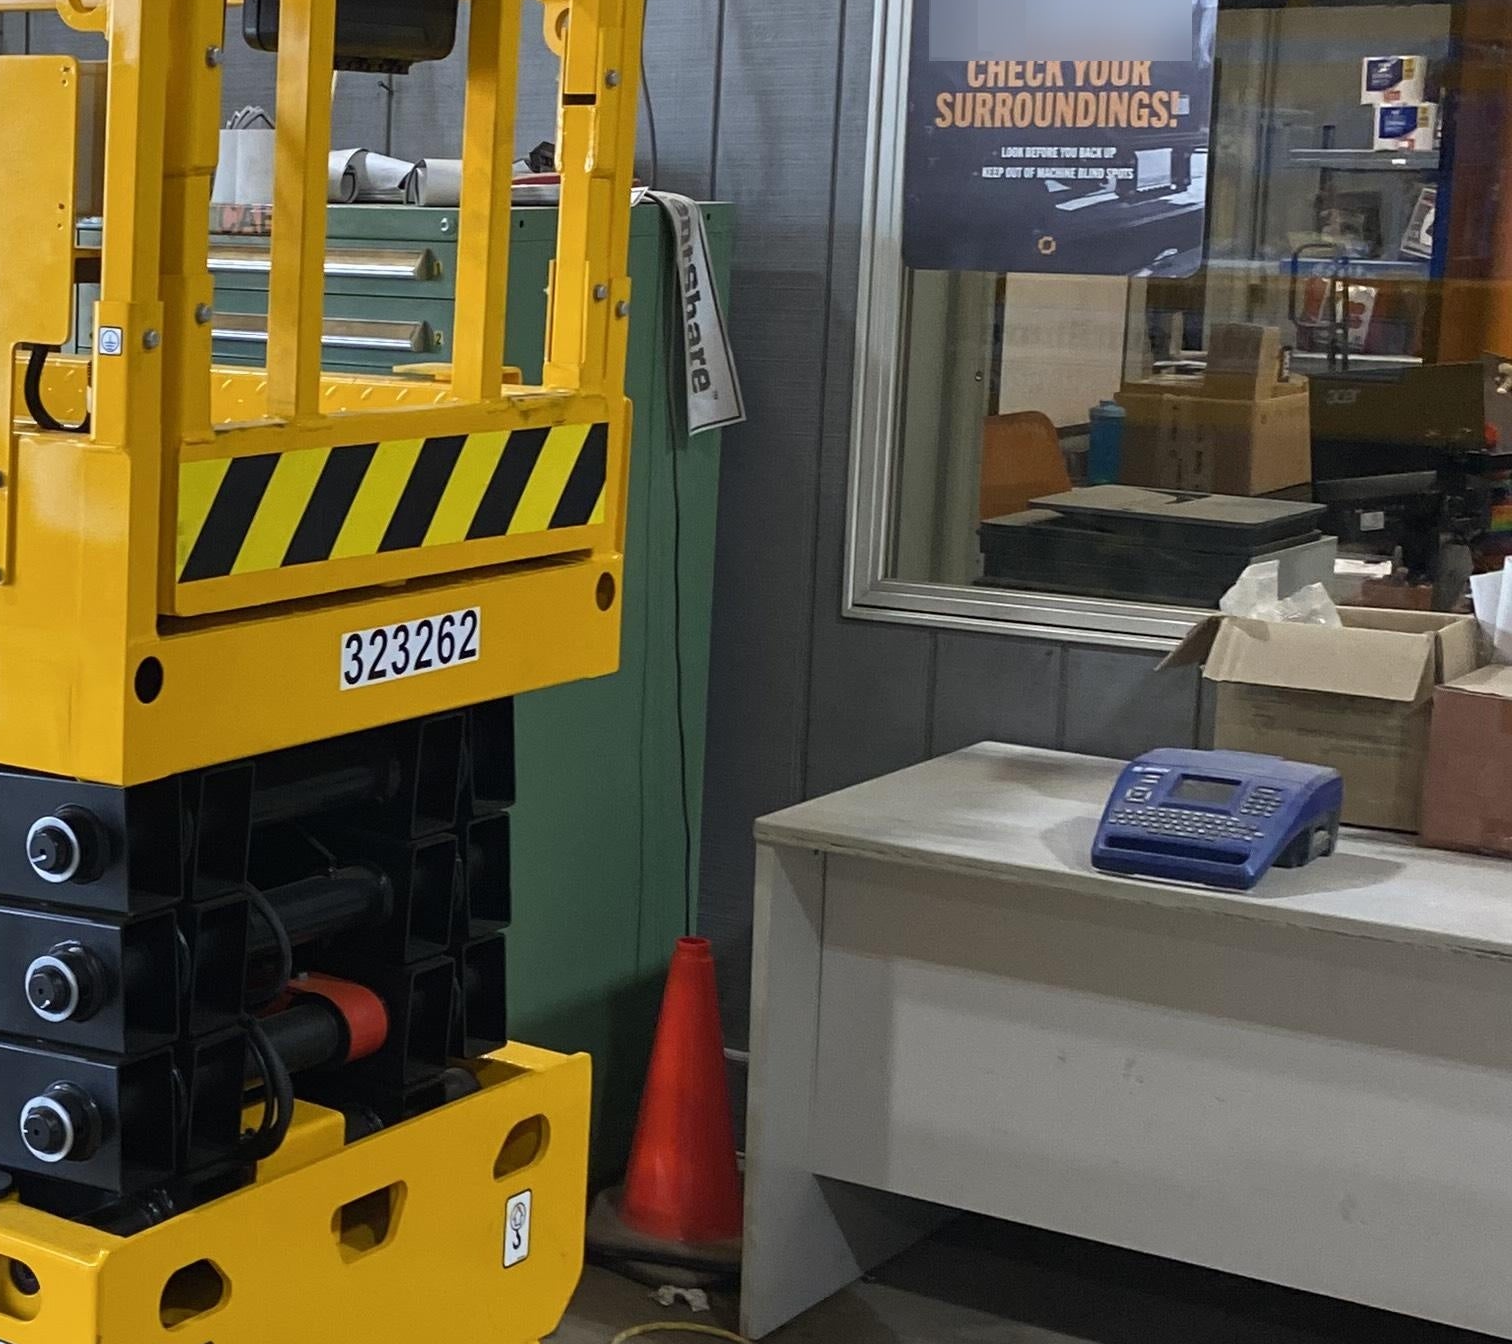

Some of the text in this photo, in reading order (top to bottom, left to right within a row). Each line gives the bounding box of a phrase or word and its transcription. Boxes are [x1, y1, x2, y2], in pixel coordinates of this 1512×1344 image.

[967, 61, 1153, 88] CHECK YOUR
[935, 91, 1180, 129] SURROUNDINGS!
[1001, 146, 1117, 158] LOOK BEFORE YOU BACK UP
[982, 167, 1134, 179] KEEP OUT OF MACHINE BLIND SPOTS
[344, 609, 477, 685] 323262
